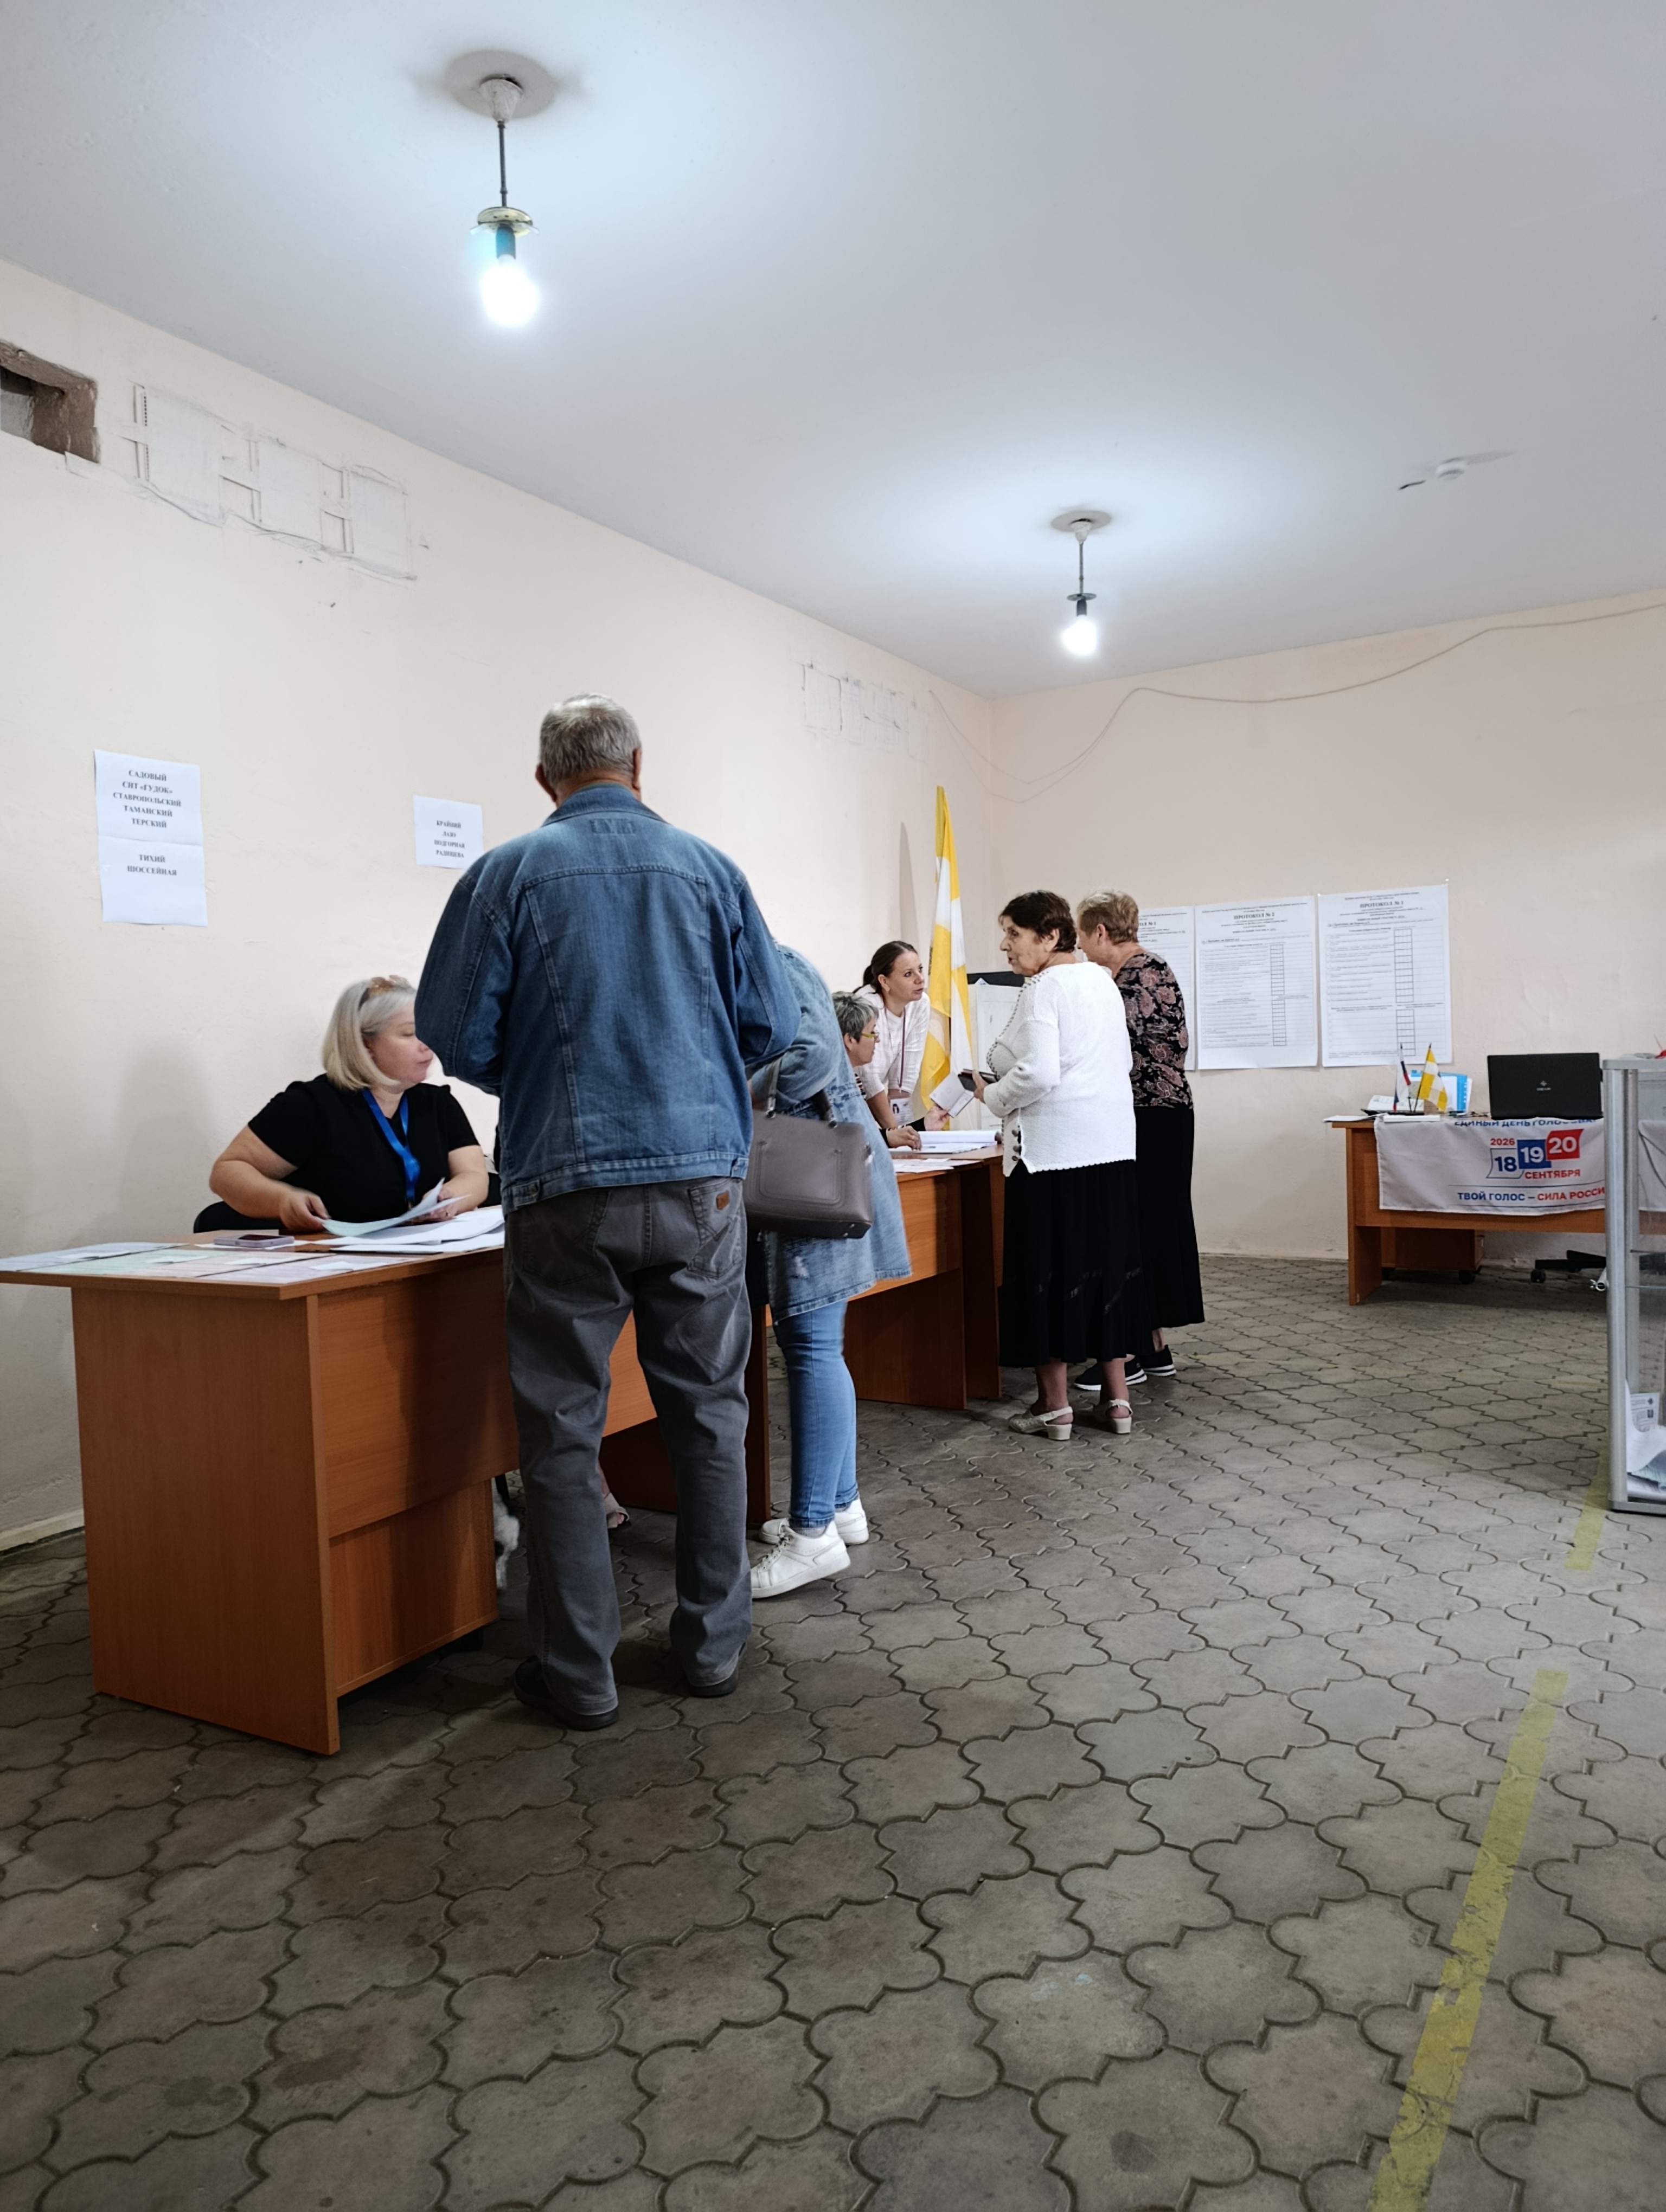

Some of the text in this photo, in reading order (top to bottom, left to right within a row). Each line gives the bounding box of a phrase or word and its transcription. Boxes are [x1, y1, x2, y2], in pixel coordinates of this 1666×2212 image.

[129, 770, 166, 781] САДОВЫЙ
[122, 781, 173, 794] СНТ «ГУДОК»
[113, 792, 181, 807] СТАВРОПОЛЬСКИЙ
[124, 805, 172, 817] ТАМАНСКИЙ
[131, 818, 166, 828] ТЕРСКИЙ
[436, 820, 461, 828] КРАЙНИЙ
[434, 840, 465, 848] ПОДГОРНАЯ
[139, 854, 165, 863] ТИХИЙ
[127, 865, 177, 876] ШОССЕЙНАЯ
[1495, 1136, 1577, 1172] 18 19 20
[1524, 1169, 1581, 1179] СЕНТЯБРЯ
[1457, 1191, 1486, 1200] ТВОЙ
[1489, 1193, 1526, 1201] ГОЛОС
[1537, 1192, 1567, 1201] СИЛА
[1569, 1187, 1605, 1200] РОССИ
